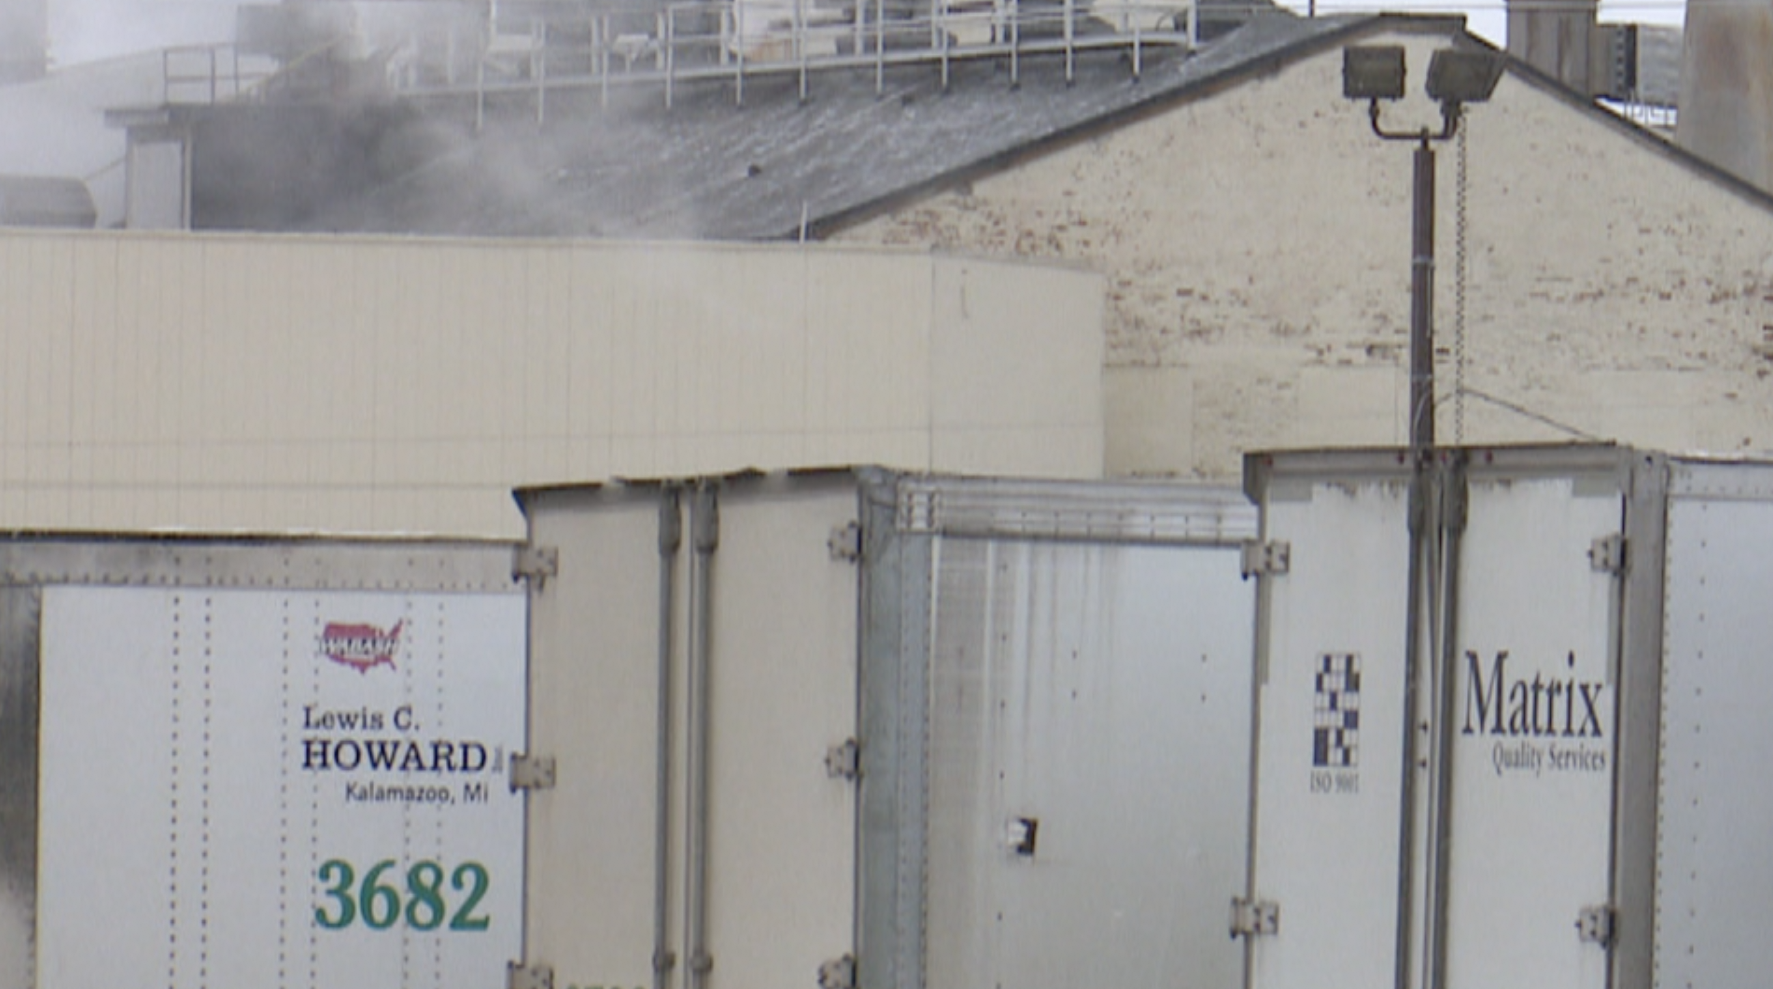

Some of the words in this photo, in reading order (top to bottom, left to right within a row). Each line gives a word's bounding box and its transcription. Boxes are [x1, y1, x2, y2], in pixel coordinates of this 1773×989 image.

[1462, 650, 1603, 738] Matrix
[303, 706, 384, 731] Lewis
[393, 705, 420, 731] C.
[302, 739, 488, 772] HOWARD
[1492, 742, 1544, 776] Quality
[1548, 742, 1606, 772] Services
[345, 780, 456, 806] Kalamazoo,
[463, 782, 489, 804] Mi
[1310, 770, 1332, 794] ISO
[315, 859, 490, 931] 3682
